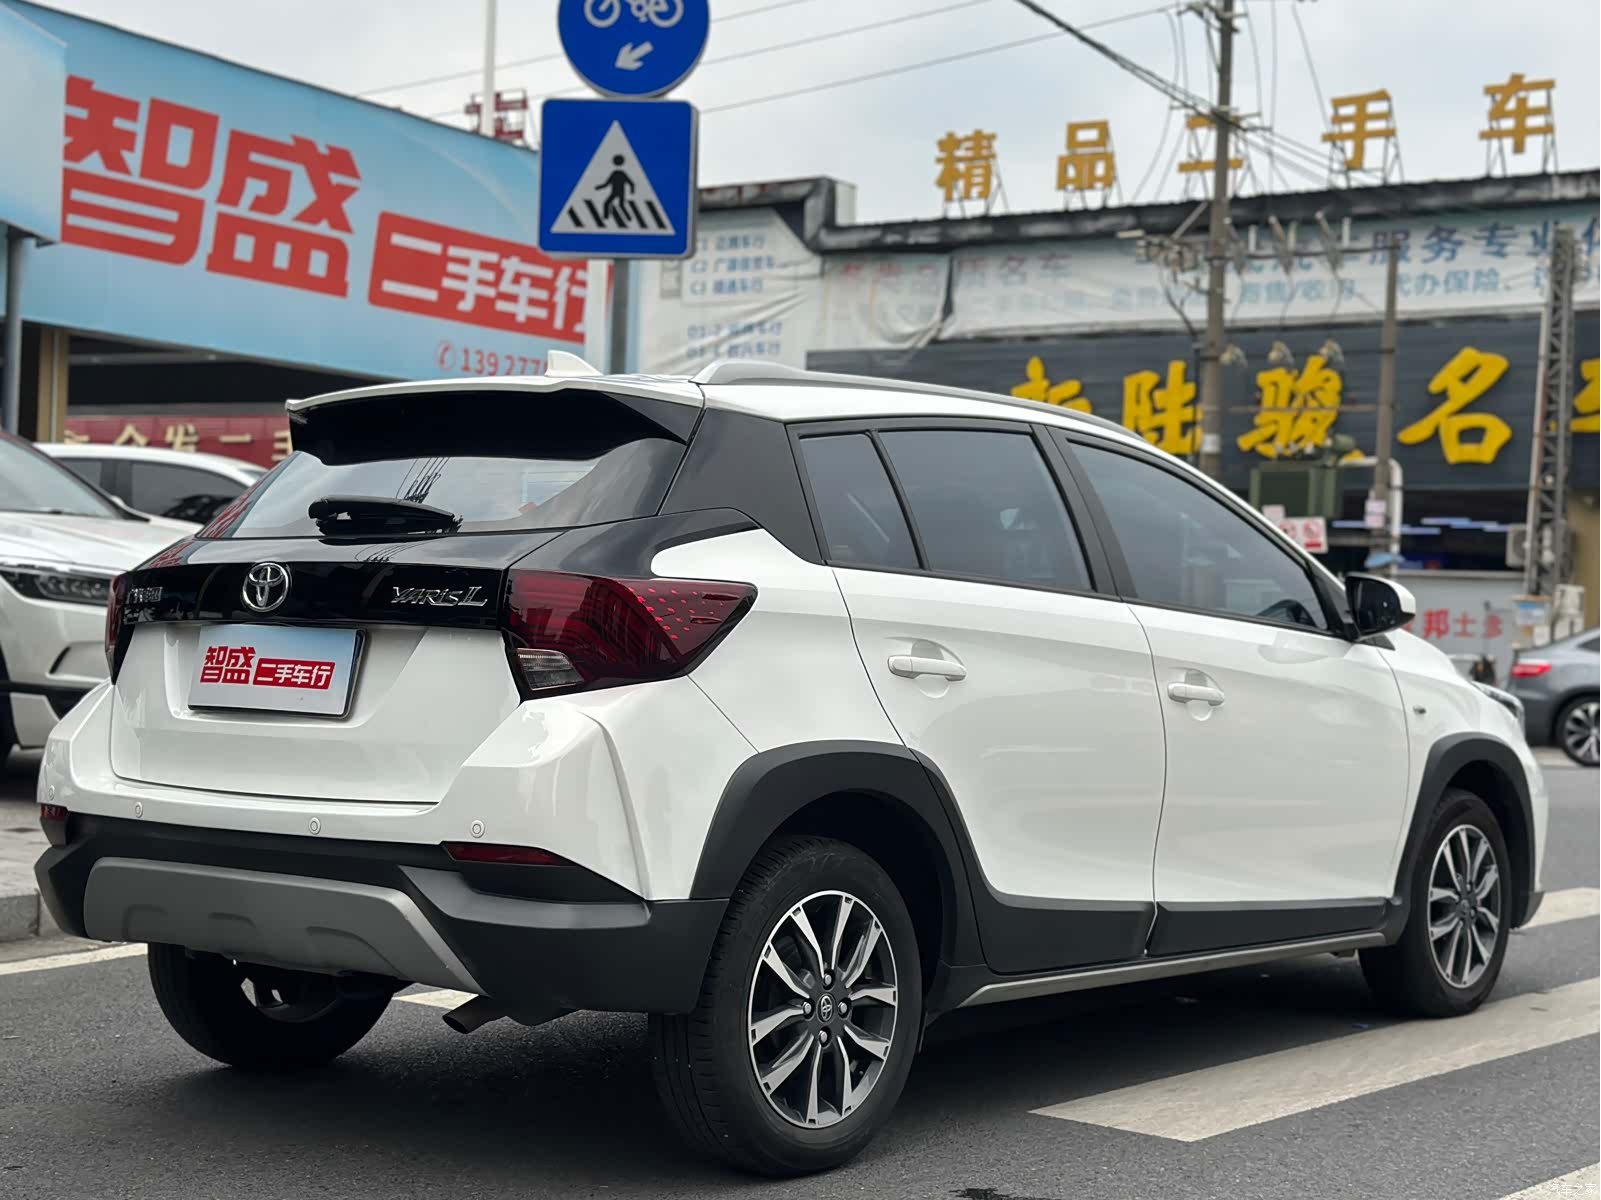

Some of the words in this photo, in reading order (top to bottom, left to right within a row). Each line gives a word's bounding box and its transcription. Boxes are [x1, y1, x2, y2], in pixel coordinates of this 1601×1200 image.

[936, 74, 1555, 201] 精品二手车
[61, 74, 361, 299] 智盛
[381, 232, 588, 333] 二手车行
[460, 347, 499, 376] 139
[503, 355, 549, 377] 277
[1010, 346, 1599, 465] 陆骏名
[1403, 608, 1503, 640] 邦士多
[200, 645, 256, 684] 智盛
[256, 663, 331, 686] 二手车行
